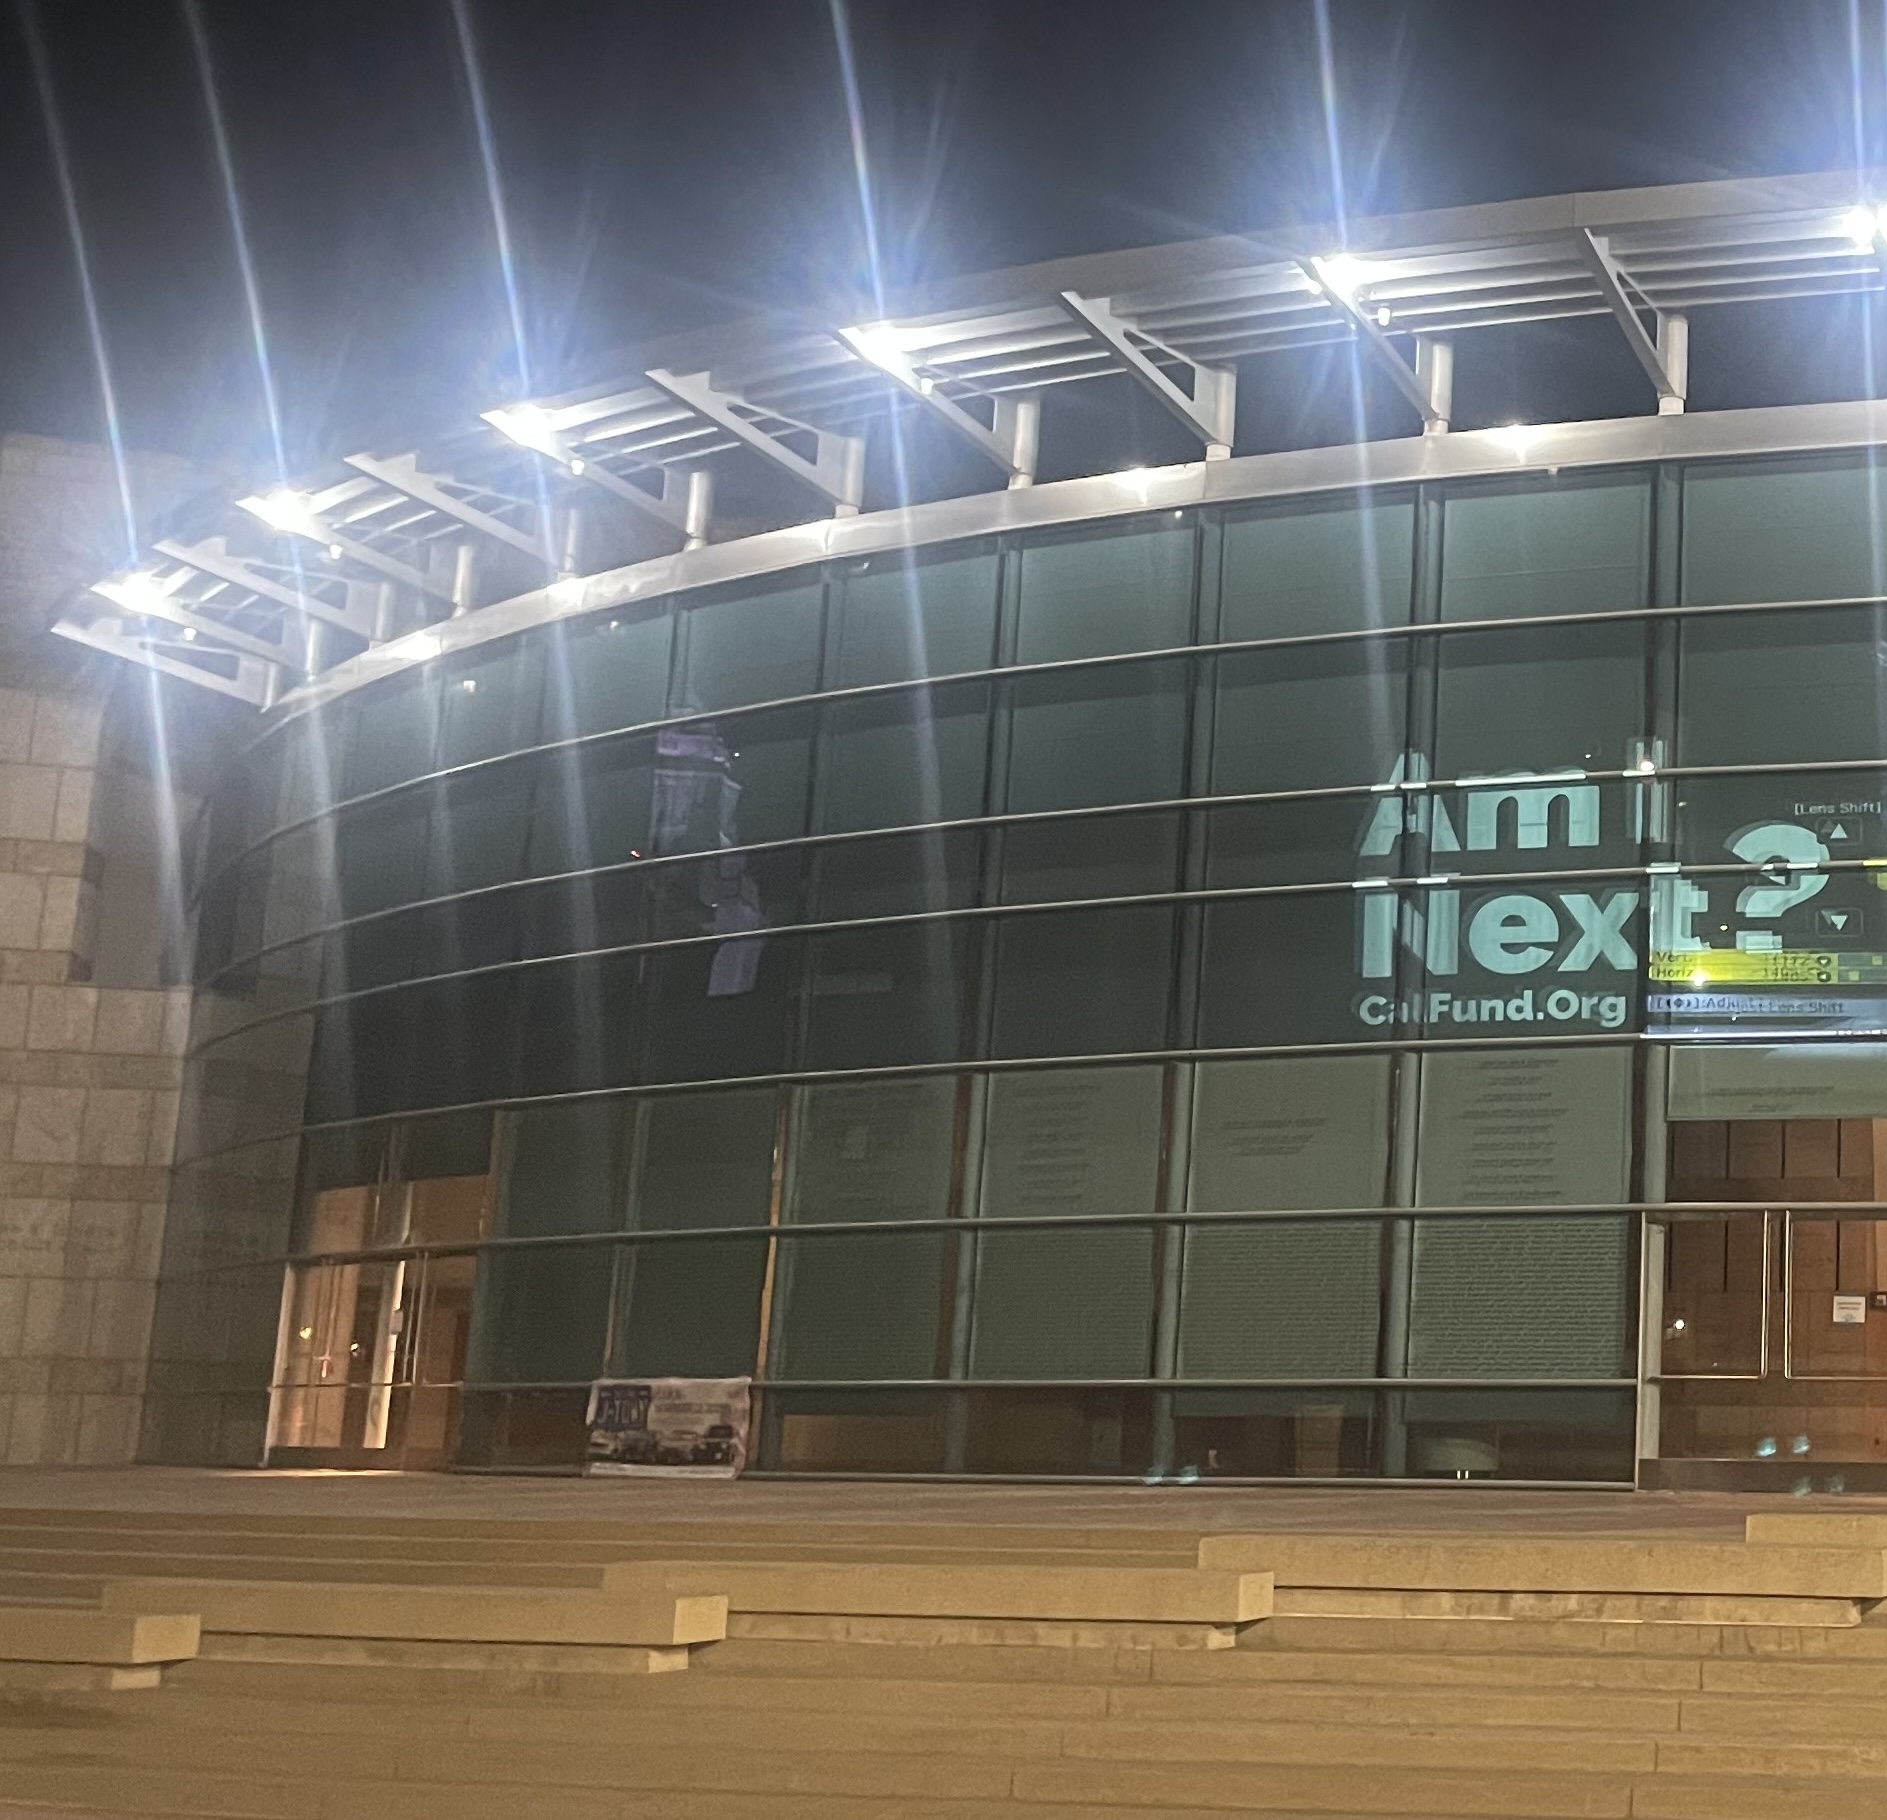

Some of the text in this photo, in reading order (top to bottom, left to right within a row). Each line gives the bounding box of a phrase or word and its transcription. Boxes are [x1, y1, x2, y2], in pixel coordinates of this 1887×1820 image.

[1358, 750, 1600, 857] Am
[1794, 801, 1882, 816] [Lens Shift]
[1360, 820, 1832, 979] Next?
[1359, 989, 1628, 1029] CalFund.Org
